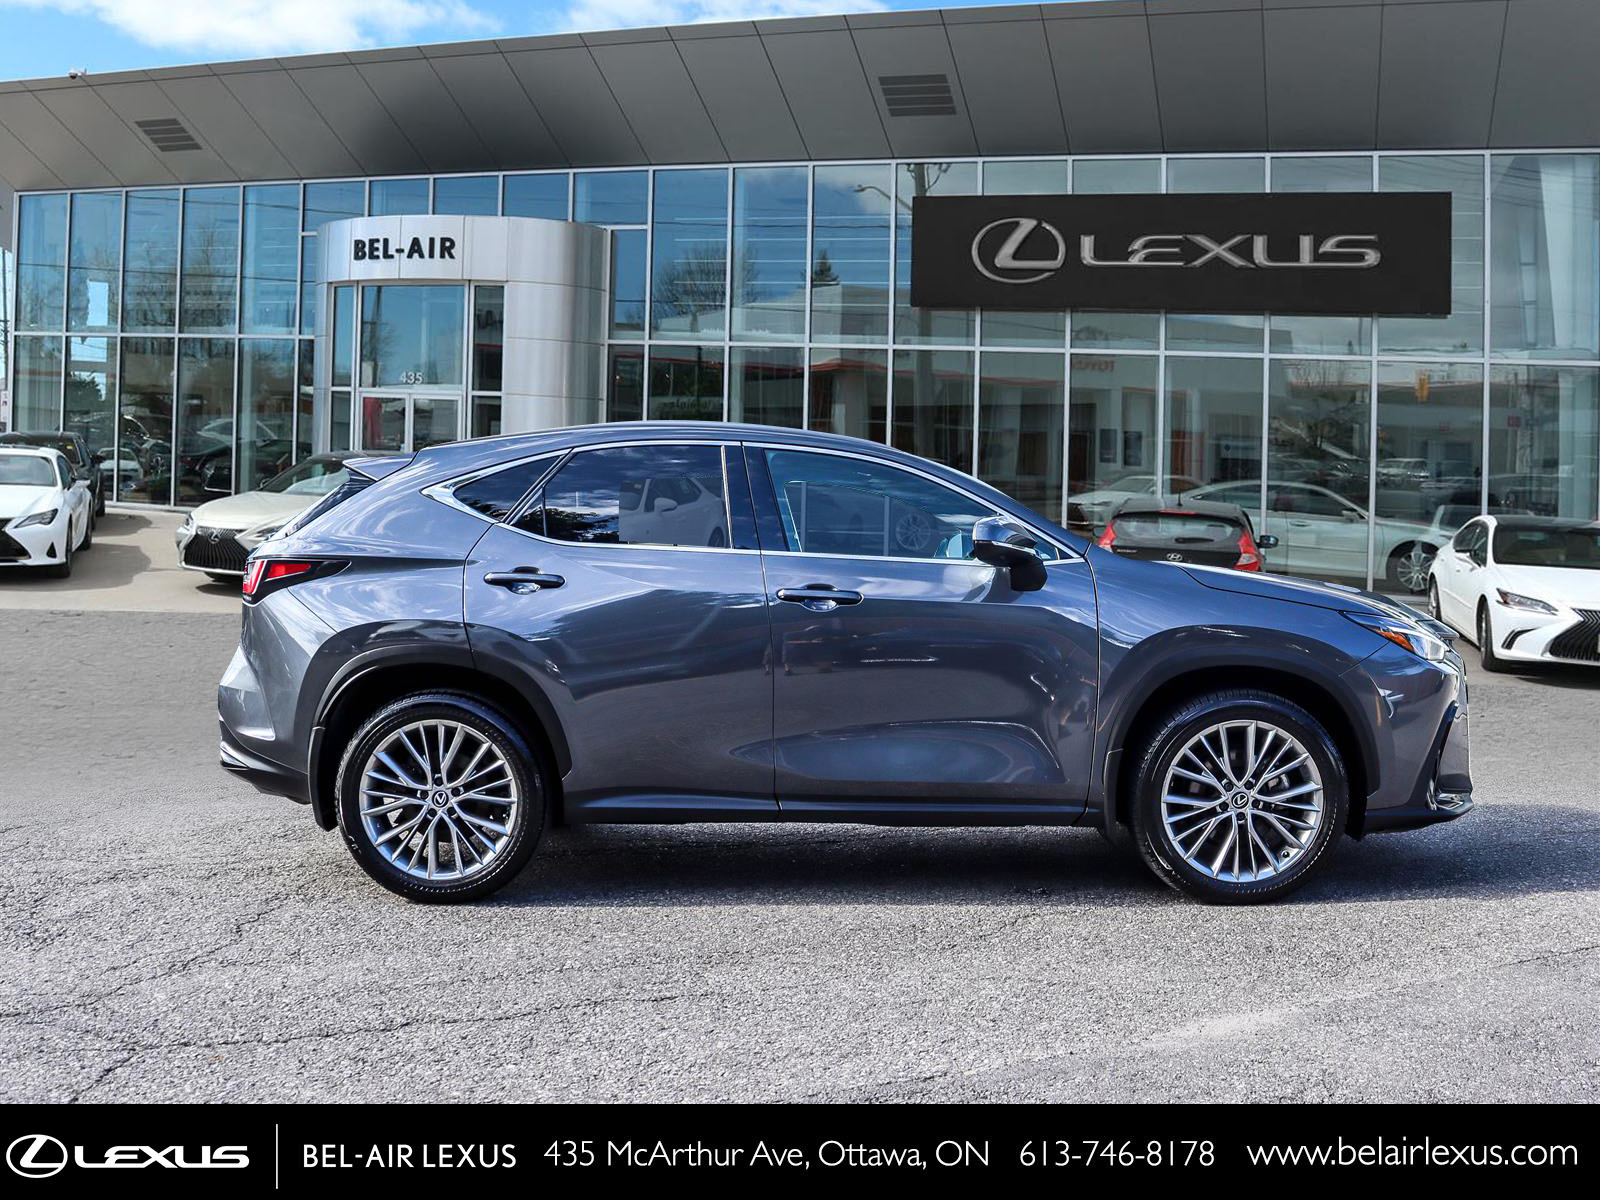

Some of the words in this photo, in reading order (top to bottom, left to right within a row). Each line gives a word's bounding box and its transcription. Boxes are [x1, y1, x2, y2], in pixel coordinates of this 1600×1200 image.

[353, 236, 456, 261] BEL-AIR
[1079, 234, 1382, 269] LEXUS
[399, 370, 423, 385] 435
